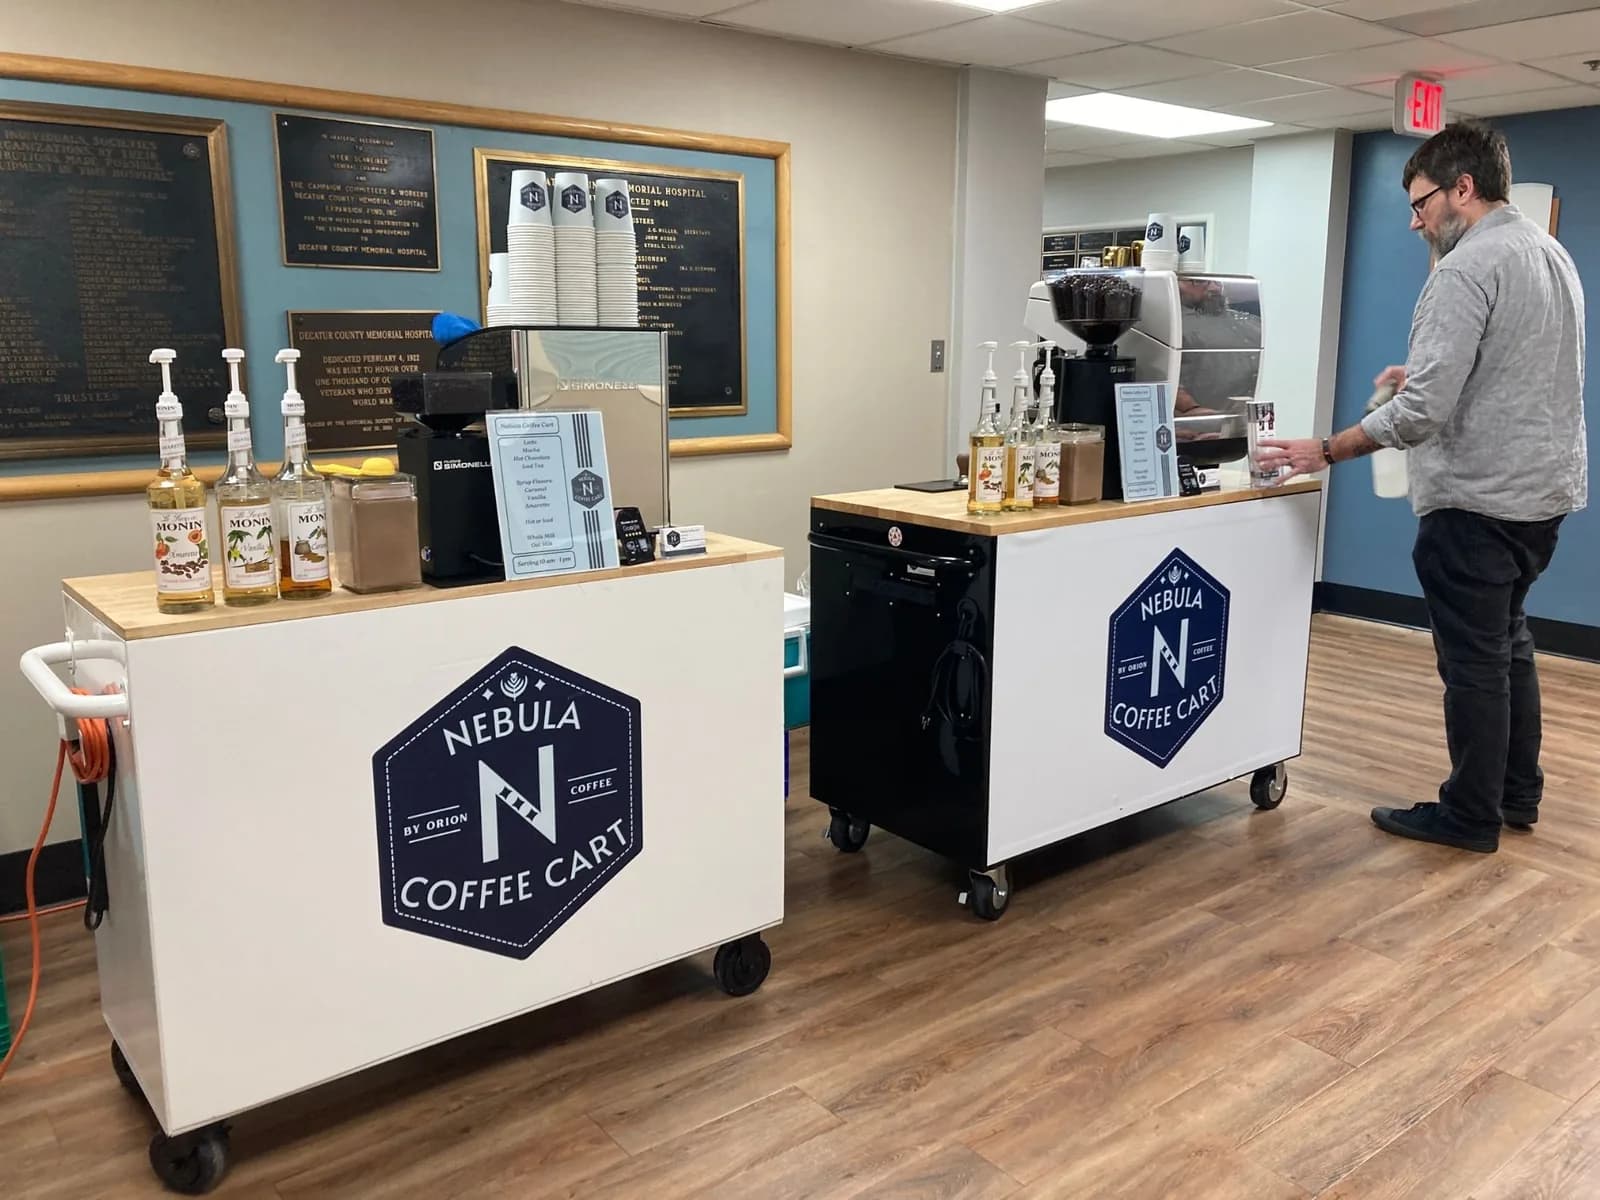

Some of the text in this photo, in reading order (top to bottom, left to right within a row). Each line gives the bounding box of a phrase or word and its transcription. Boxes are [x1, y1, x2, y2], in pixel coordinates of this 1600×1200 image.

[1412, 80, 1444, 131] EXIT
[529, 192, 539, 202] N
[628, 184, 707, 199] MORIAL HOSPITAL
[569, 194, 579, 204] N
[614, 200, 623, 210] N
[397, 248, 428, 257] HOSPITAL
[299, 329, 433, 341] DECATUR COUNTY MEMORIAL HOSPITA
[322, 355, 362, 364] DEDICATED
[362, 354, 397, 363] FEBRUARY
[342, 366, 363, 374] BUILT
[363, 366, 373, 374] TO
[374, 365, 399, 373] HONOR
[400, 365, 419, 373] OVER
[331, 377, 368, 386] THOUSAND
[320, 388, 356, 397] VETERANS
[357, 388, 374, 396] WHO
[352, 397, 393, 407] WORLD WAR
[444, 461, 492, 470] SIMONELL
[582, 481, 594, 496] N
[156, 520, 202, 531] MONIN
[1141, 586, 1203, 622] NEBULA
[1193, 644, 1214, 656] COFFEE
[1150, 617, 1190, 698] N
[1117, 661, 1148, 675] BY ORION
[1112, 674, 1219, 730] COFFEE CART
[443, 700, 581, 756] NEBULA
[570, 777, 613, 796] COFFEE
[478, 744, 557, 864] N
[403, 812, 468, 837] BY ORION
[400, 818, 627, 911] COFFEE CART
